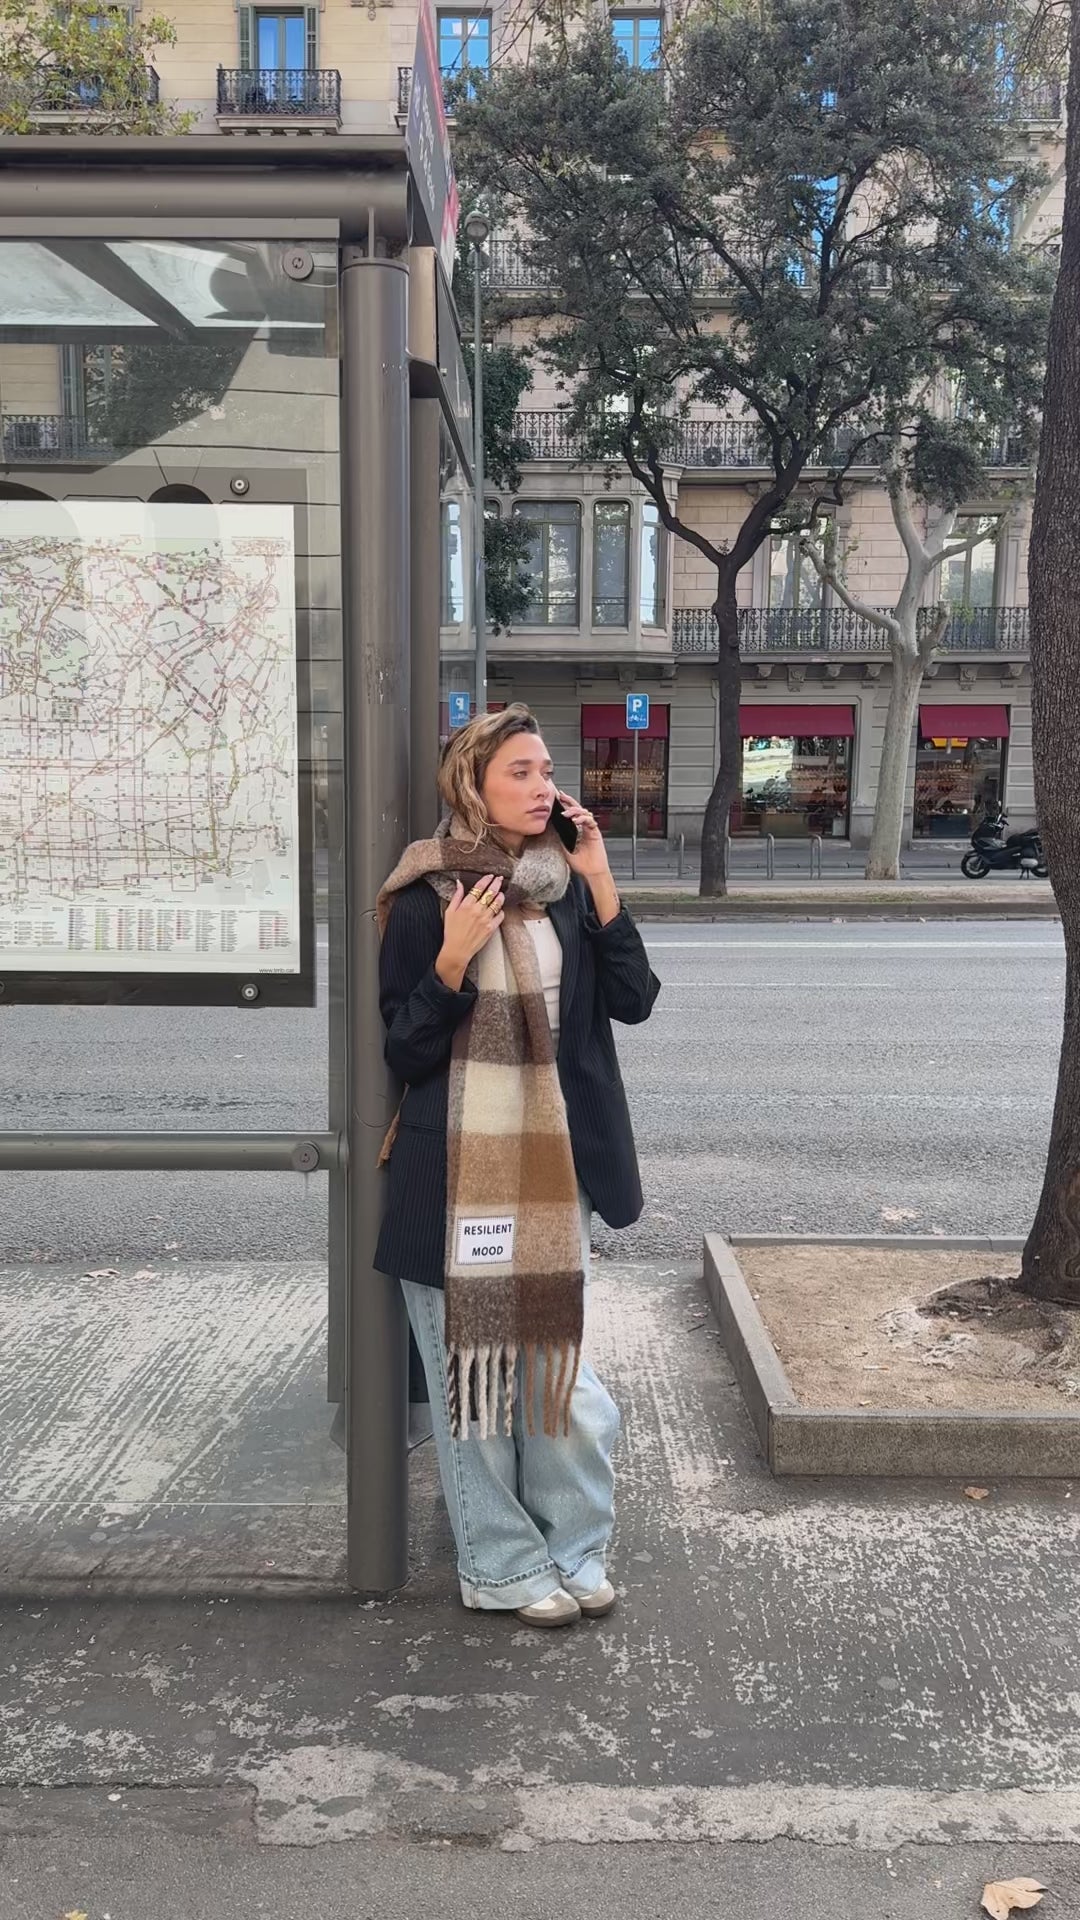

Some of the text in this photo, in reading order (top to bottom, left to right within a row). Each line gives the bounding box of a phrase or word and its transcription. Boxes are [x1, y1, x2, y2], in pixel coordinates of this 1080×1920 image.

[632, 698, 642, 712] P
[464, 1223, 512, 1235] RESILIENT
[471, 1245, 504, 1256] MOOD
